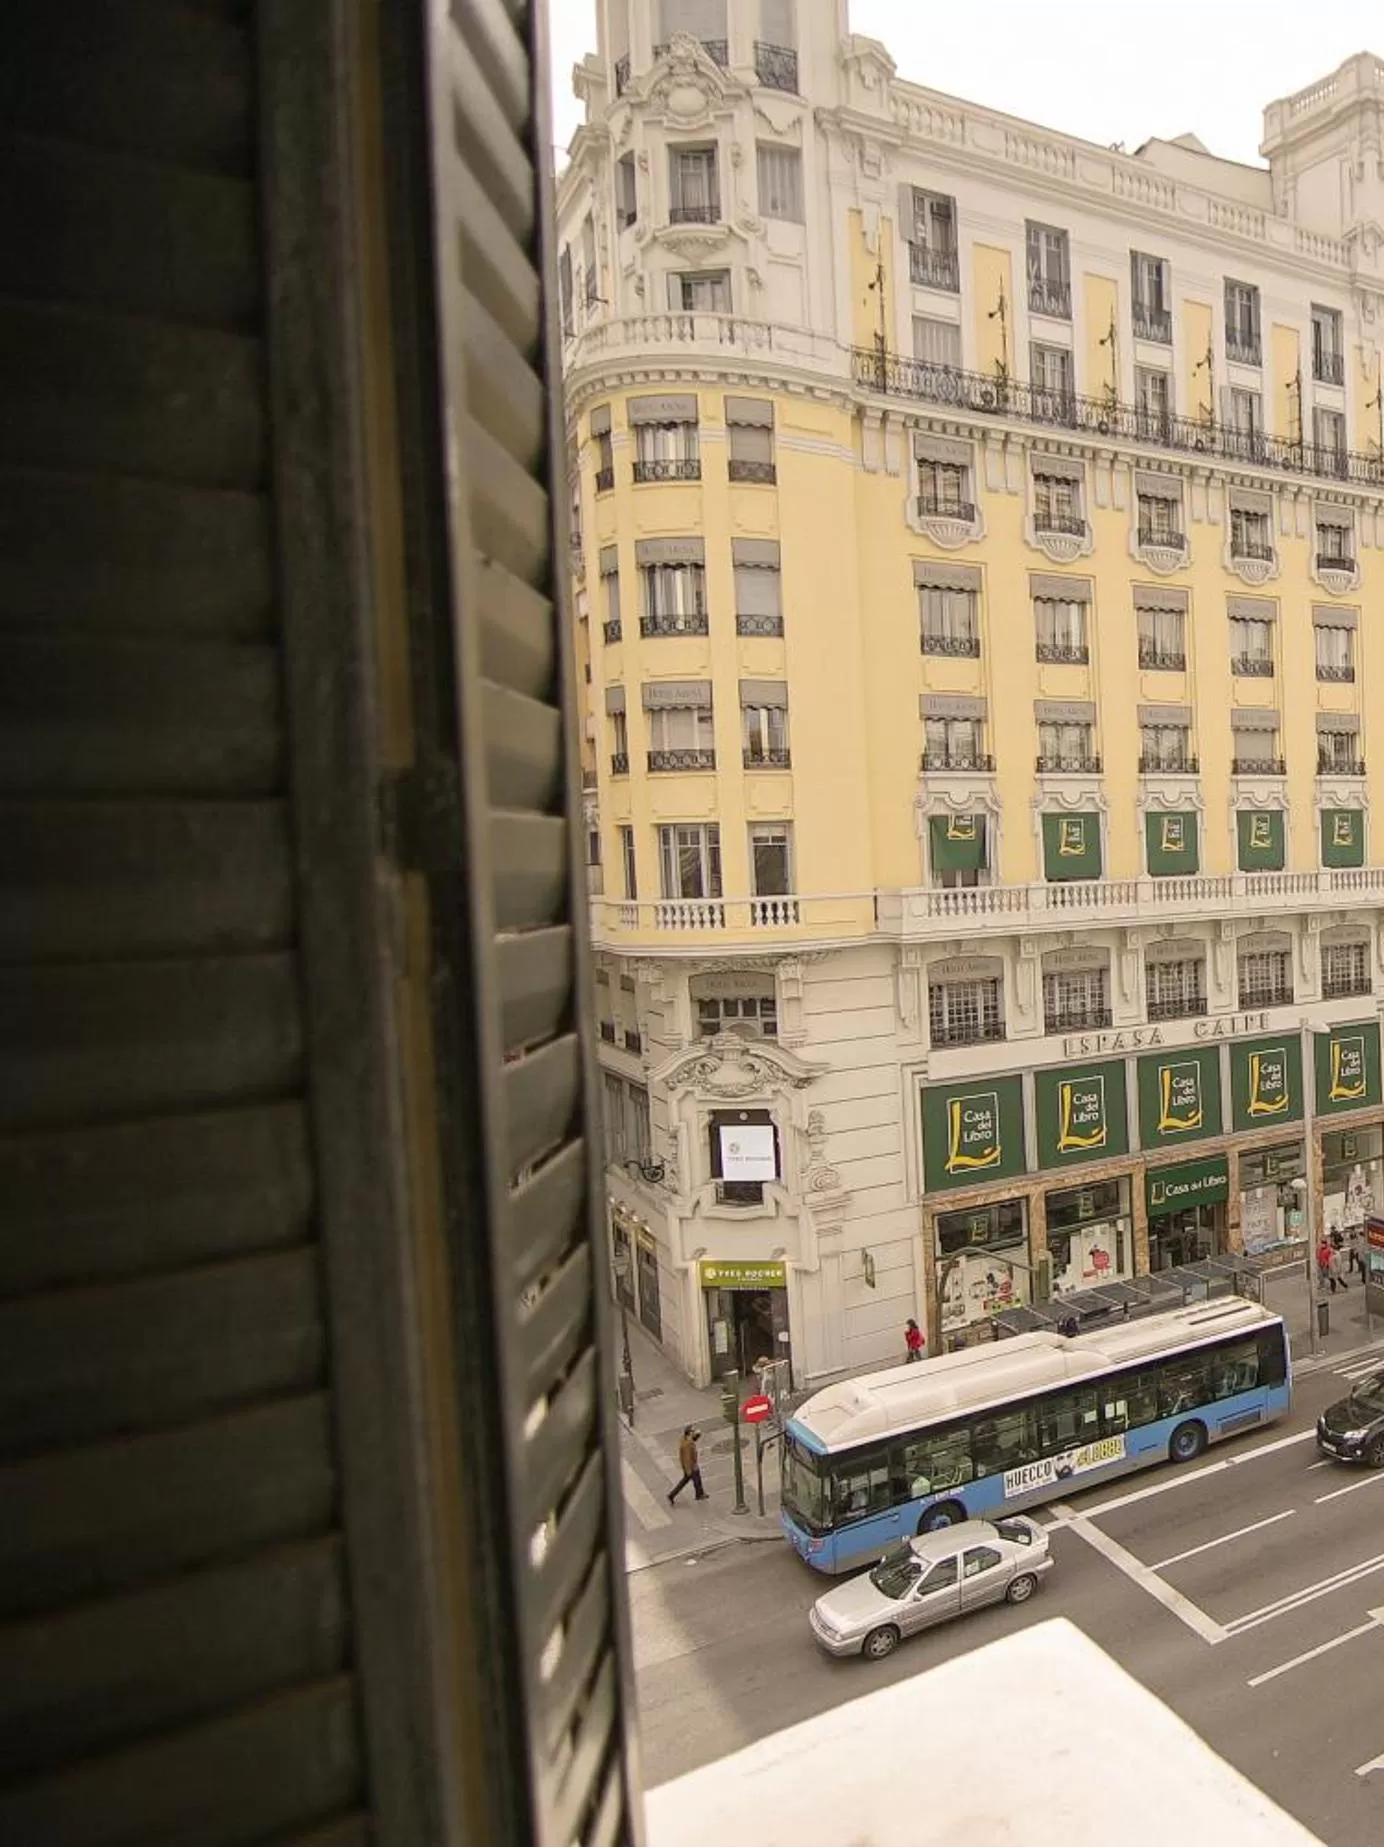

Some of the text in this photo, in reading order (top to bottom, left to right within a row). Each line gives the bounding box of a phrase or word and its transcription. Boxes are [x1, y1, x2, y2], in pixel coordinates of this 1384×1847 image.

[1064, 1012, 1271, 1057] ESPASA CALPE
[1341, 1049, 1360, 1060] Casa
[1260, 1063, 1281, 1075] Casa
[1341, 1067, 1361, 1077] Libro
[1172, 1077, 1194, 1089] Casa
[1260, 1080, 1282, 1092] Libro
[1073, 1093, 1097, 1105] Casa
[1172, 1095, 1197, 1106] Libro
[1085, 1102, 1098, 1112] del
[964, 1110, 991, 1123] Casa
[1073, 1111, 1099, 1124] Libro
[977, 1119, 992, 1131] del
[964, 1130, 992, 1143] Libro
[1165, 1183, 1189, 1197] Casa
[1203, 1174, 1227, 1189] Libro
[1006, 1461, 1052, 1489] HUECCO
